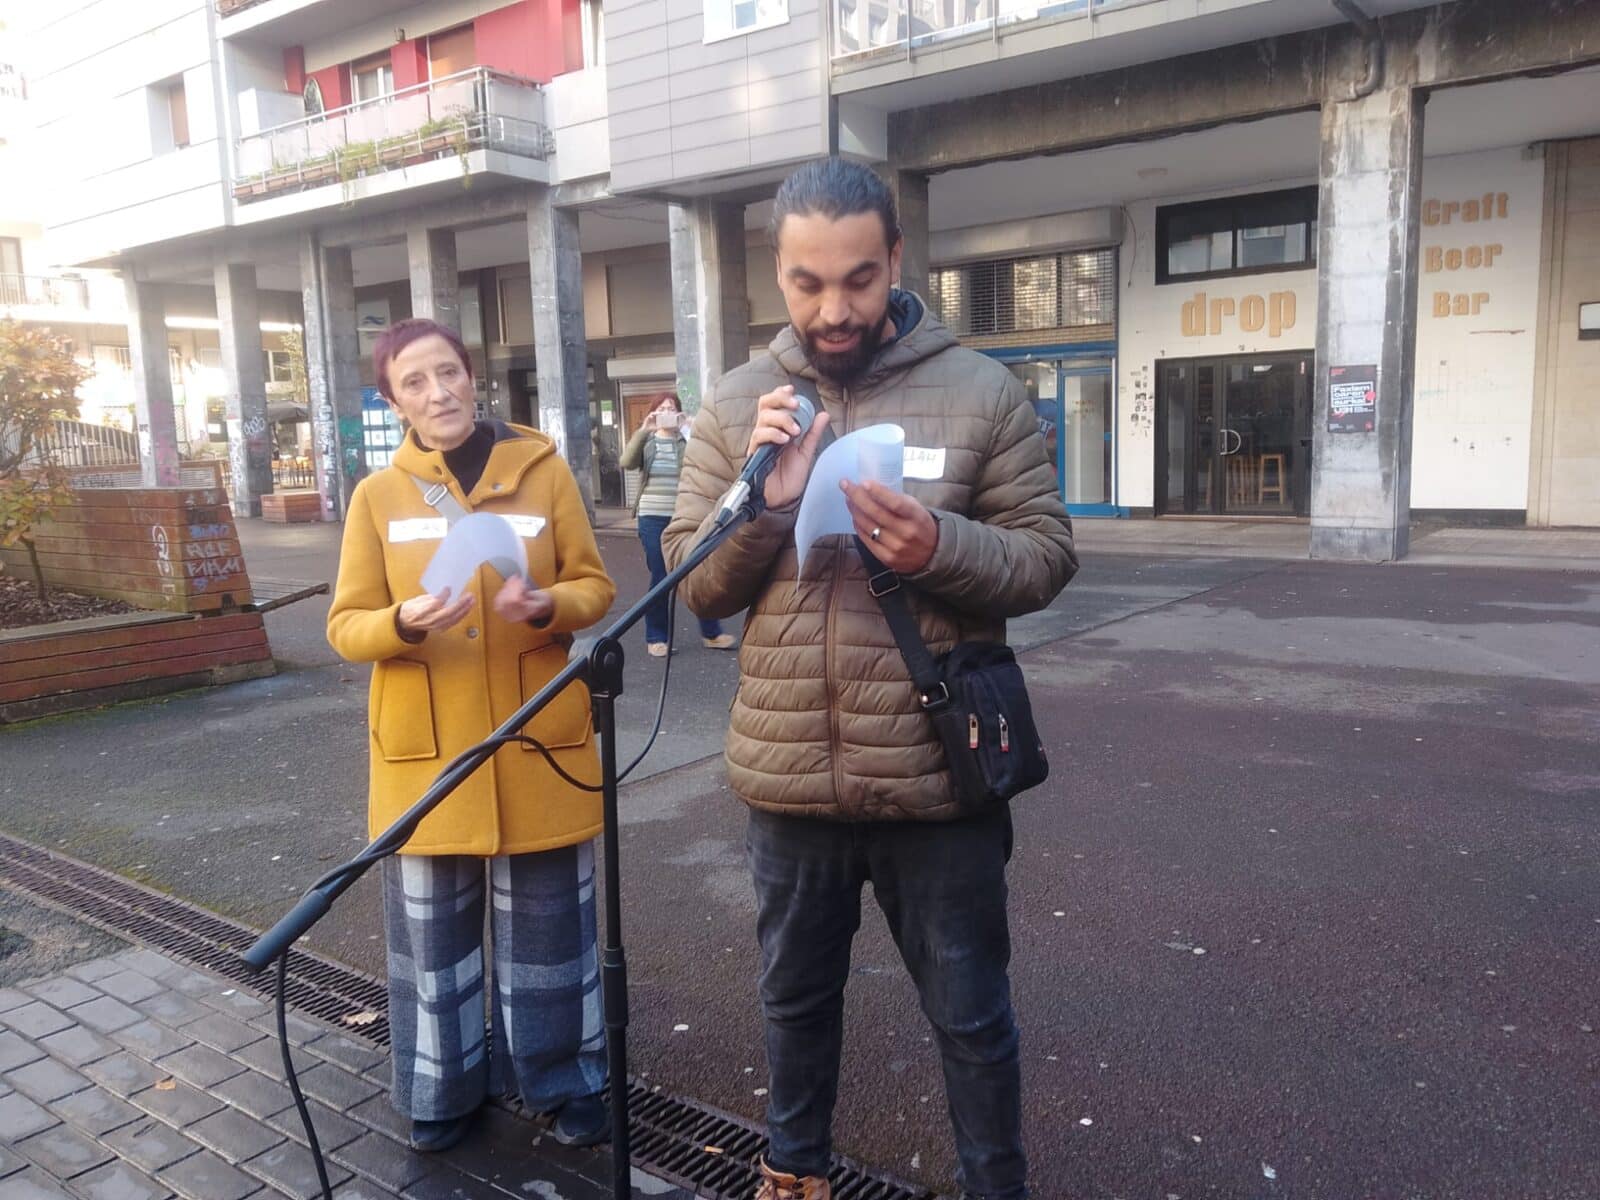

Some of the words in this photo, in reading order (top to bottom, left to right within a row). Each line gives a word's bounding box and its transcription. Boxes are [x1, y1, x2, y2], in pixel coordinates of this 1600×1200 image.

[1422, 191, 1509, 227] Craft
[1424, 243, 1503, 273] Beer
[1180, 289, 1297, 338] drop
[1432, 290, 1490, 318] Bar
